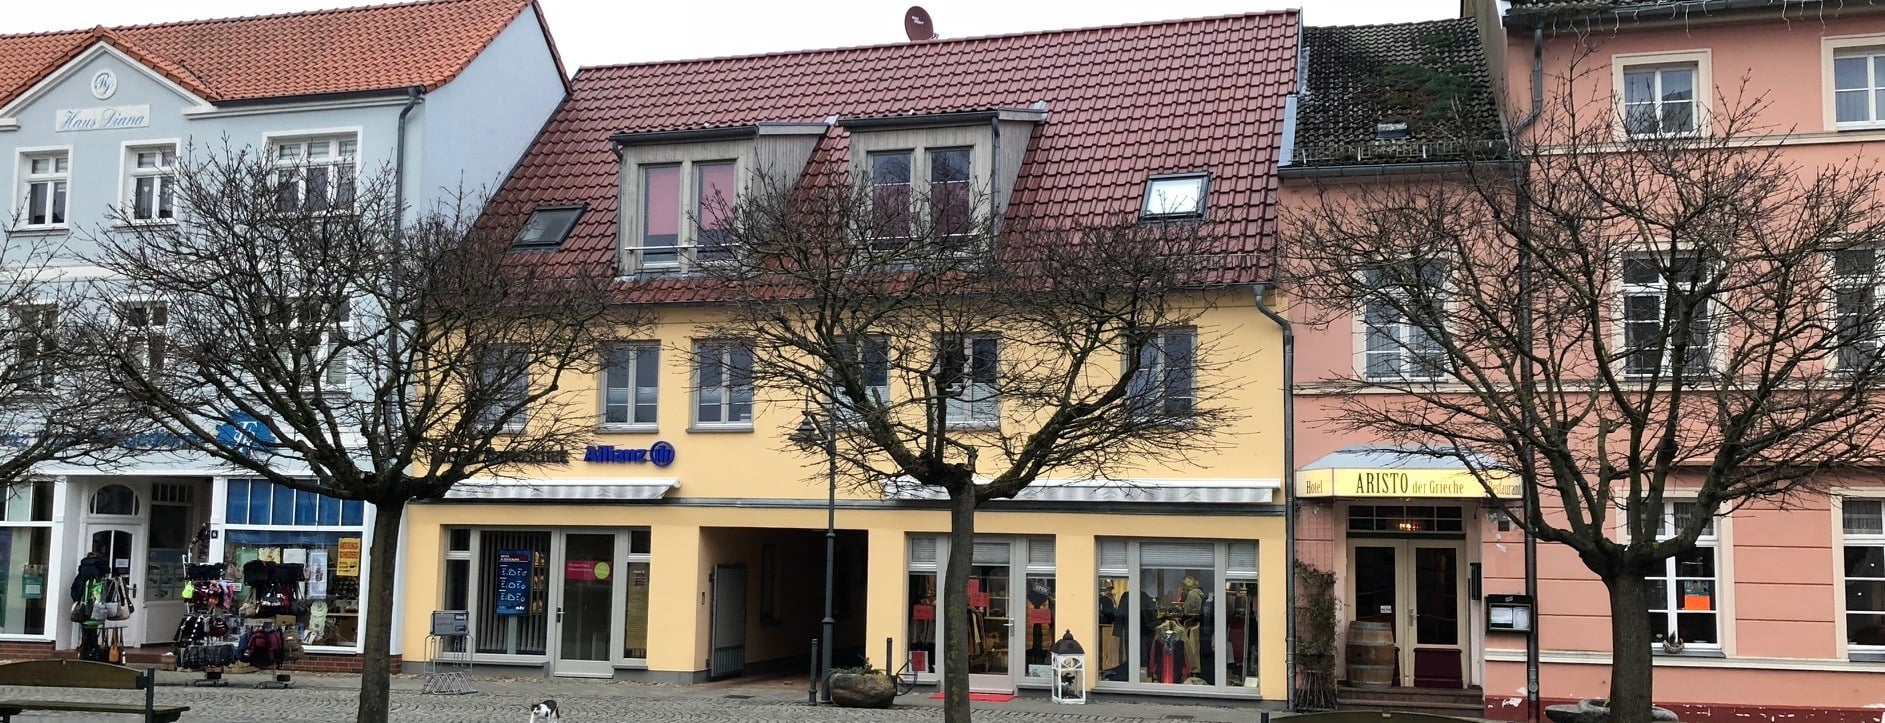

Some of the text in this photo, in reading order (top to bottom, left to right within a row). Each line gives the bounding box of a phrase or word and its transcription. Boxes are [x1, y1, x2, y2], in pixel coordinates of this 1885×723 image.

[62, 107, 145, 129] Haus Diana
[584, 445, 647, 463] Allianz
[1306, 480, 1323, 494] Hotel
[1356, 472, 1464, 494] ARISTO der Grieche
